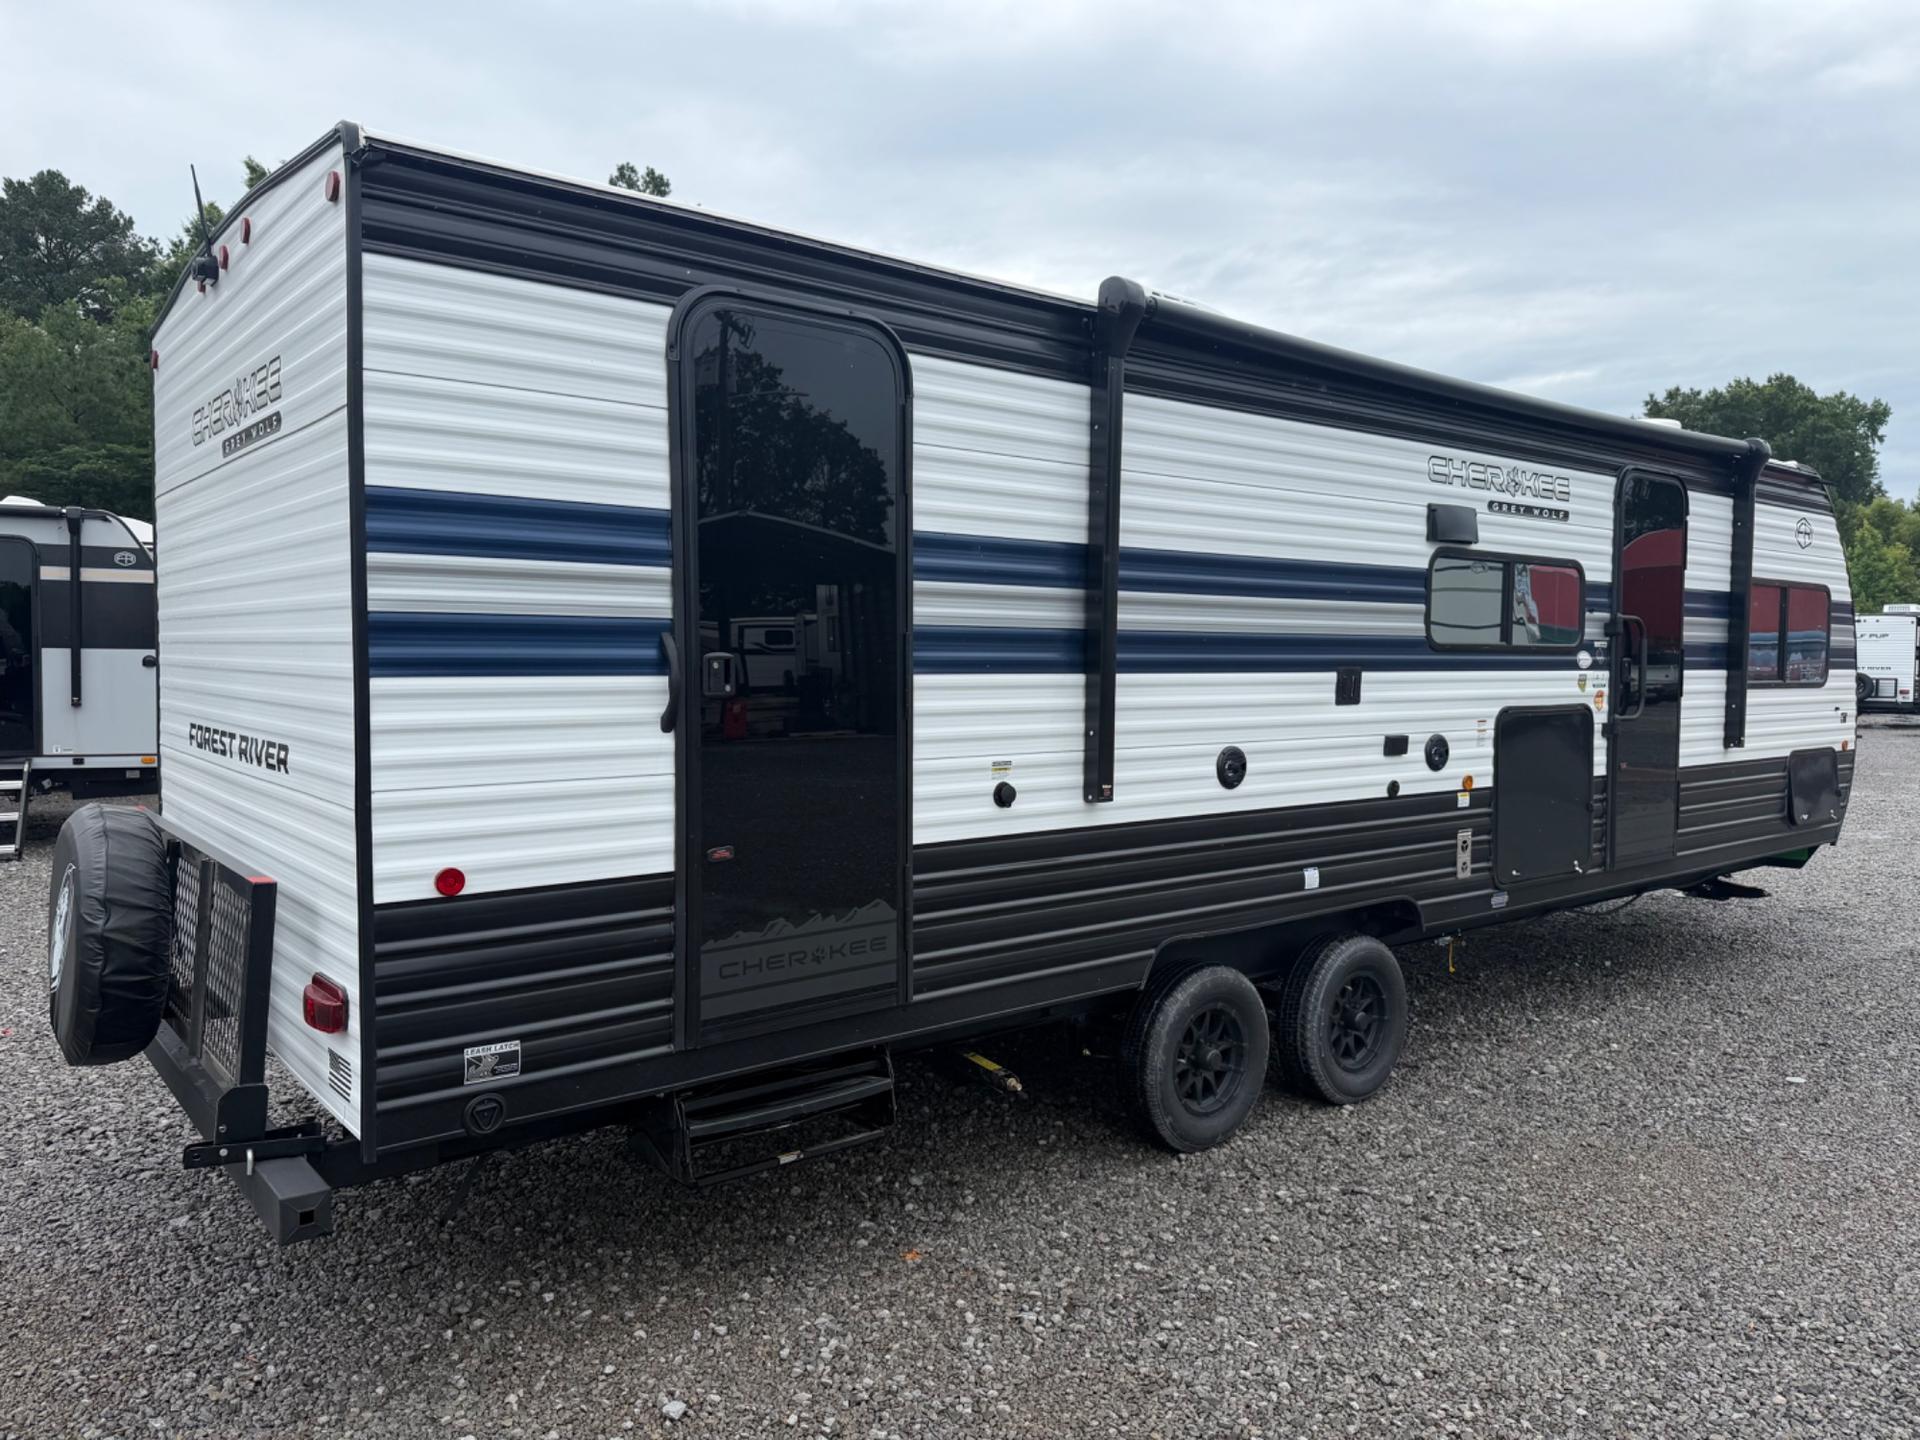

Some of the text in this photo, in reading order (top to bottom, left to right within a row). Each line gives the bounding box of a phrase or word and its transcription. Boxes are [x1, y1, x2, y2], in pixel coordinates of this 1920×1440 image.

[1427, 455, 1570, 502] CHEROKEE
[1491, 502, 1566, 520] GREY WOLF
[189, 722, 289, 775] FOREST RIVER
[718, 936, 888, 980] CHEROKEE
